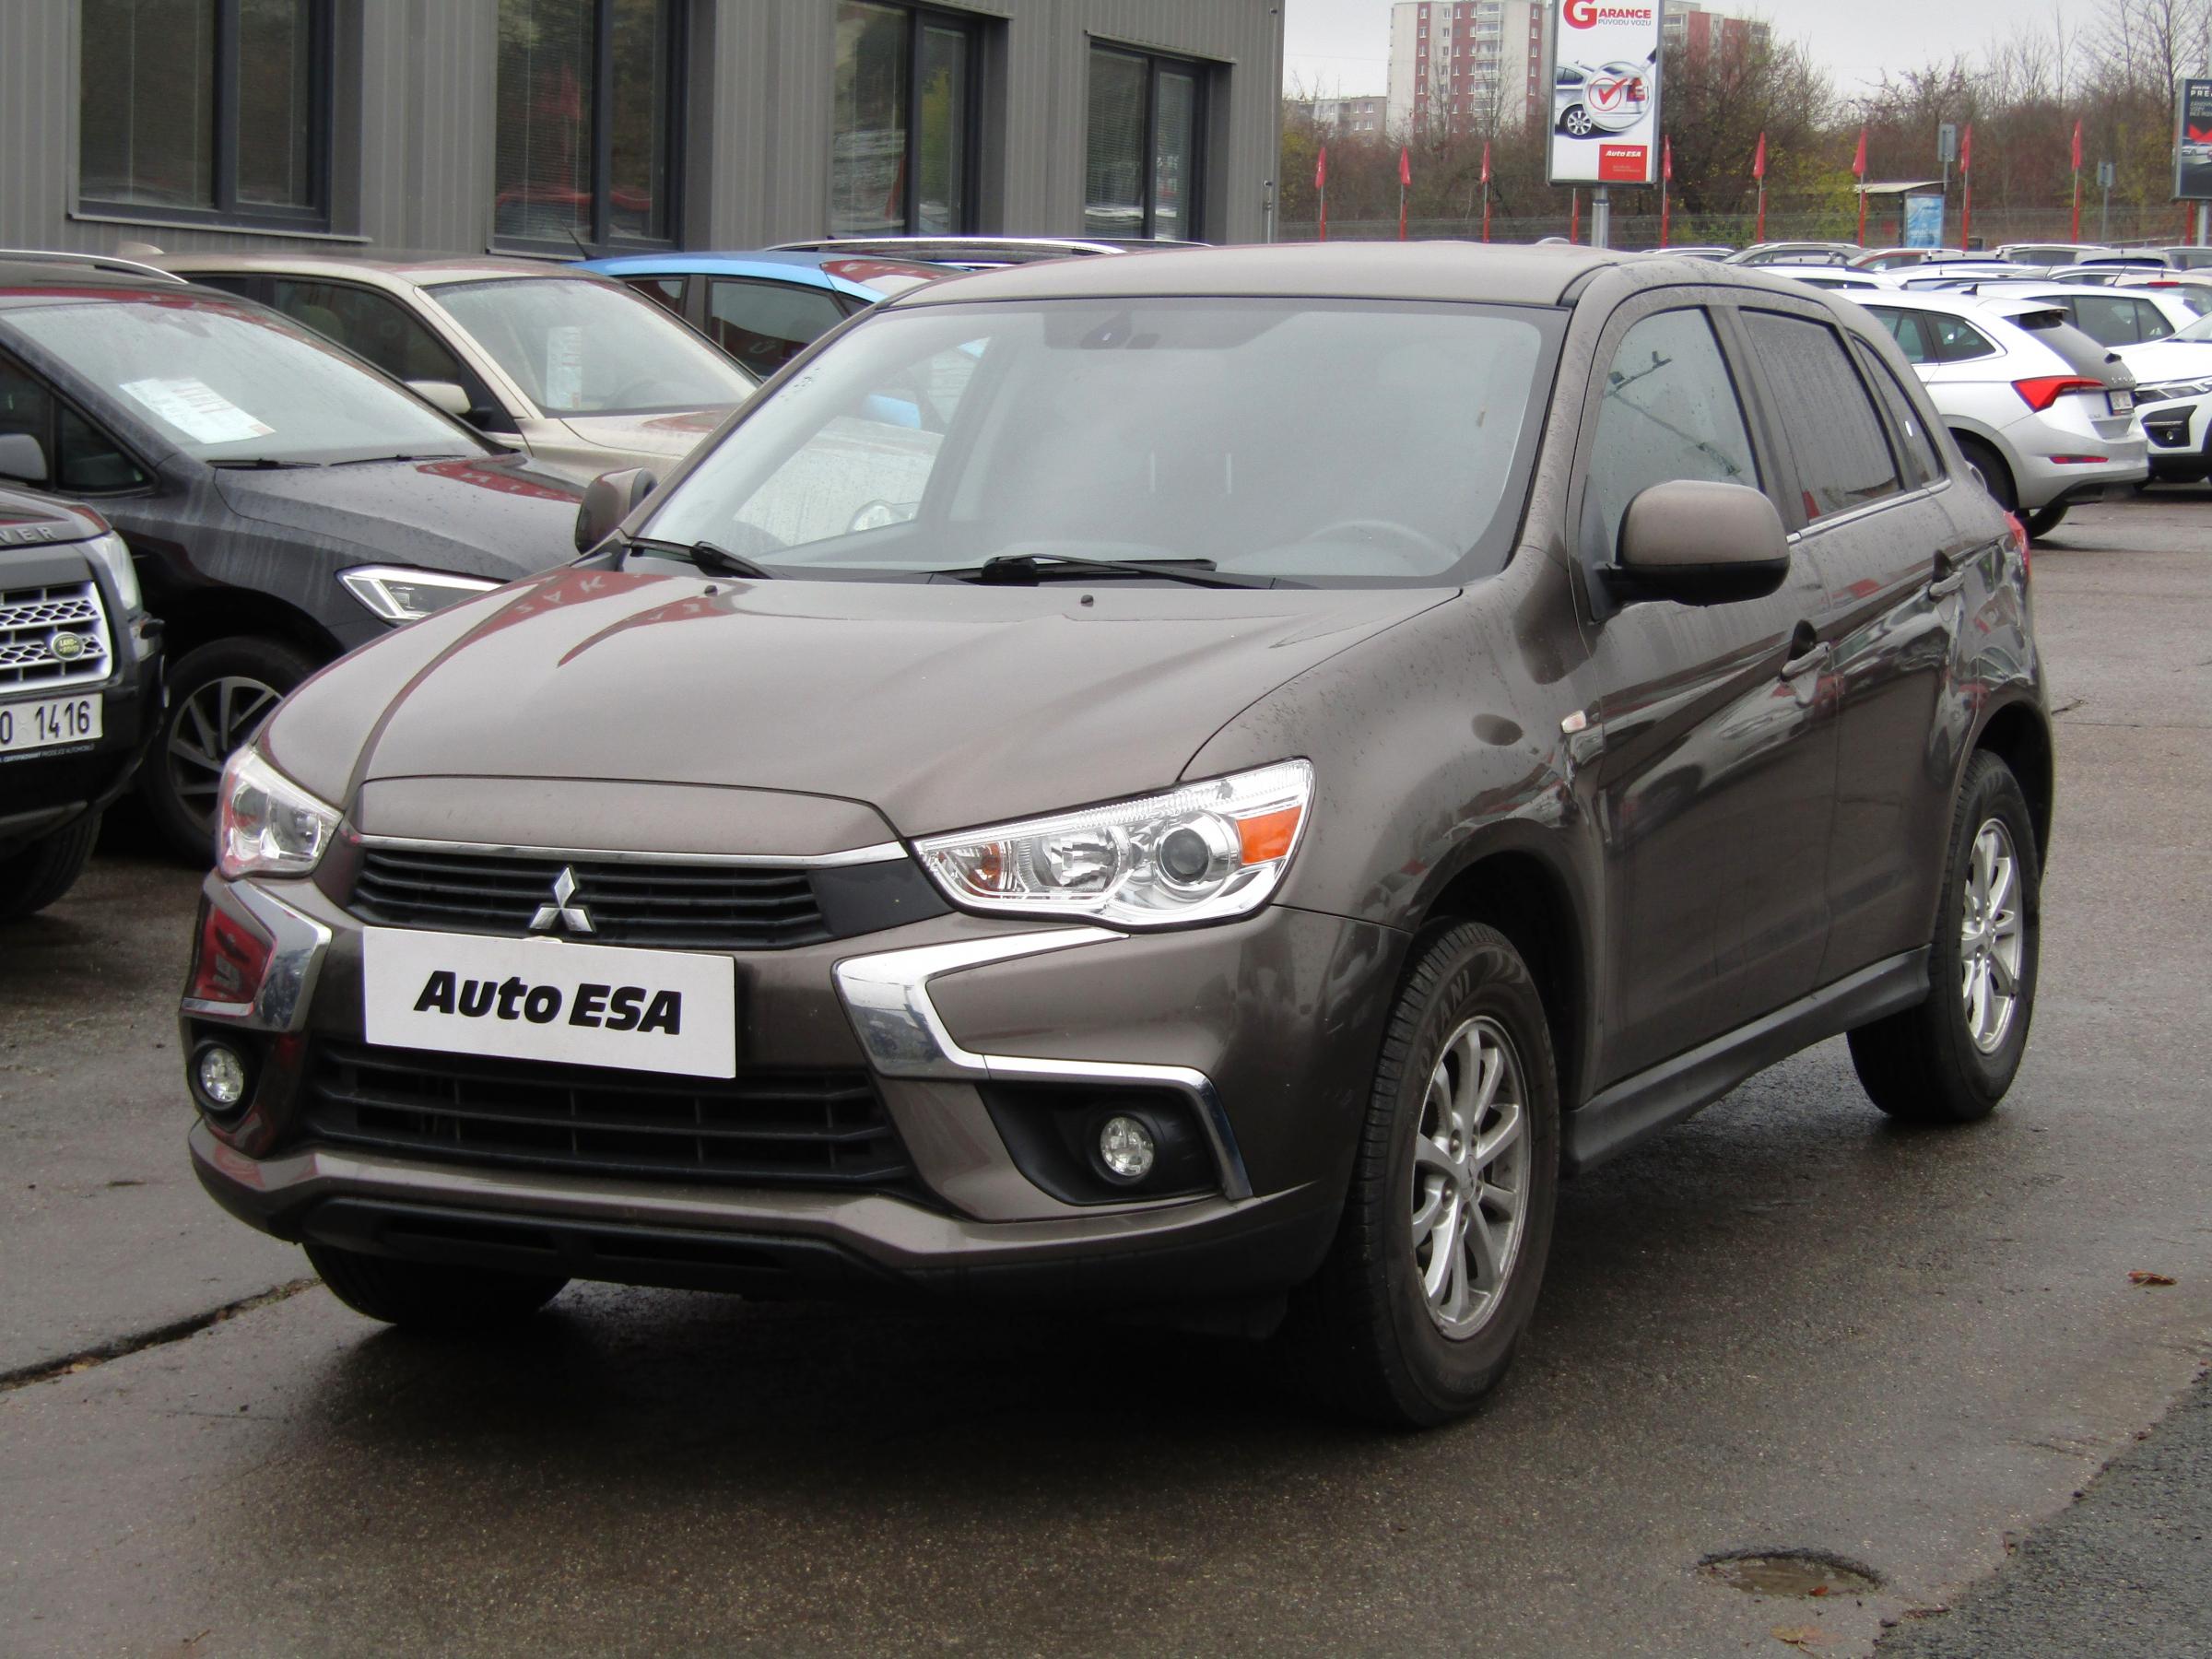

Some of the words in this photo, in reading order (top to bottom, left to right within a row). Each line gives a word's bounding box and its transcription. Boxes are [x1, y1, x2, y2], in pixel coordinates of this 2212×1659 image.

[1563, 0, 1651, 29] GARANCE
[35, 700, 90, 740] 1416
[413, 971, 562, 1023] Auto
[568, 982, 682, 1035] ESA
